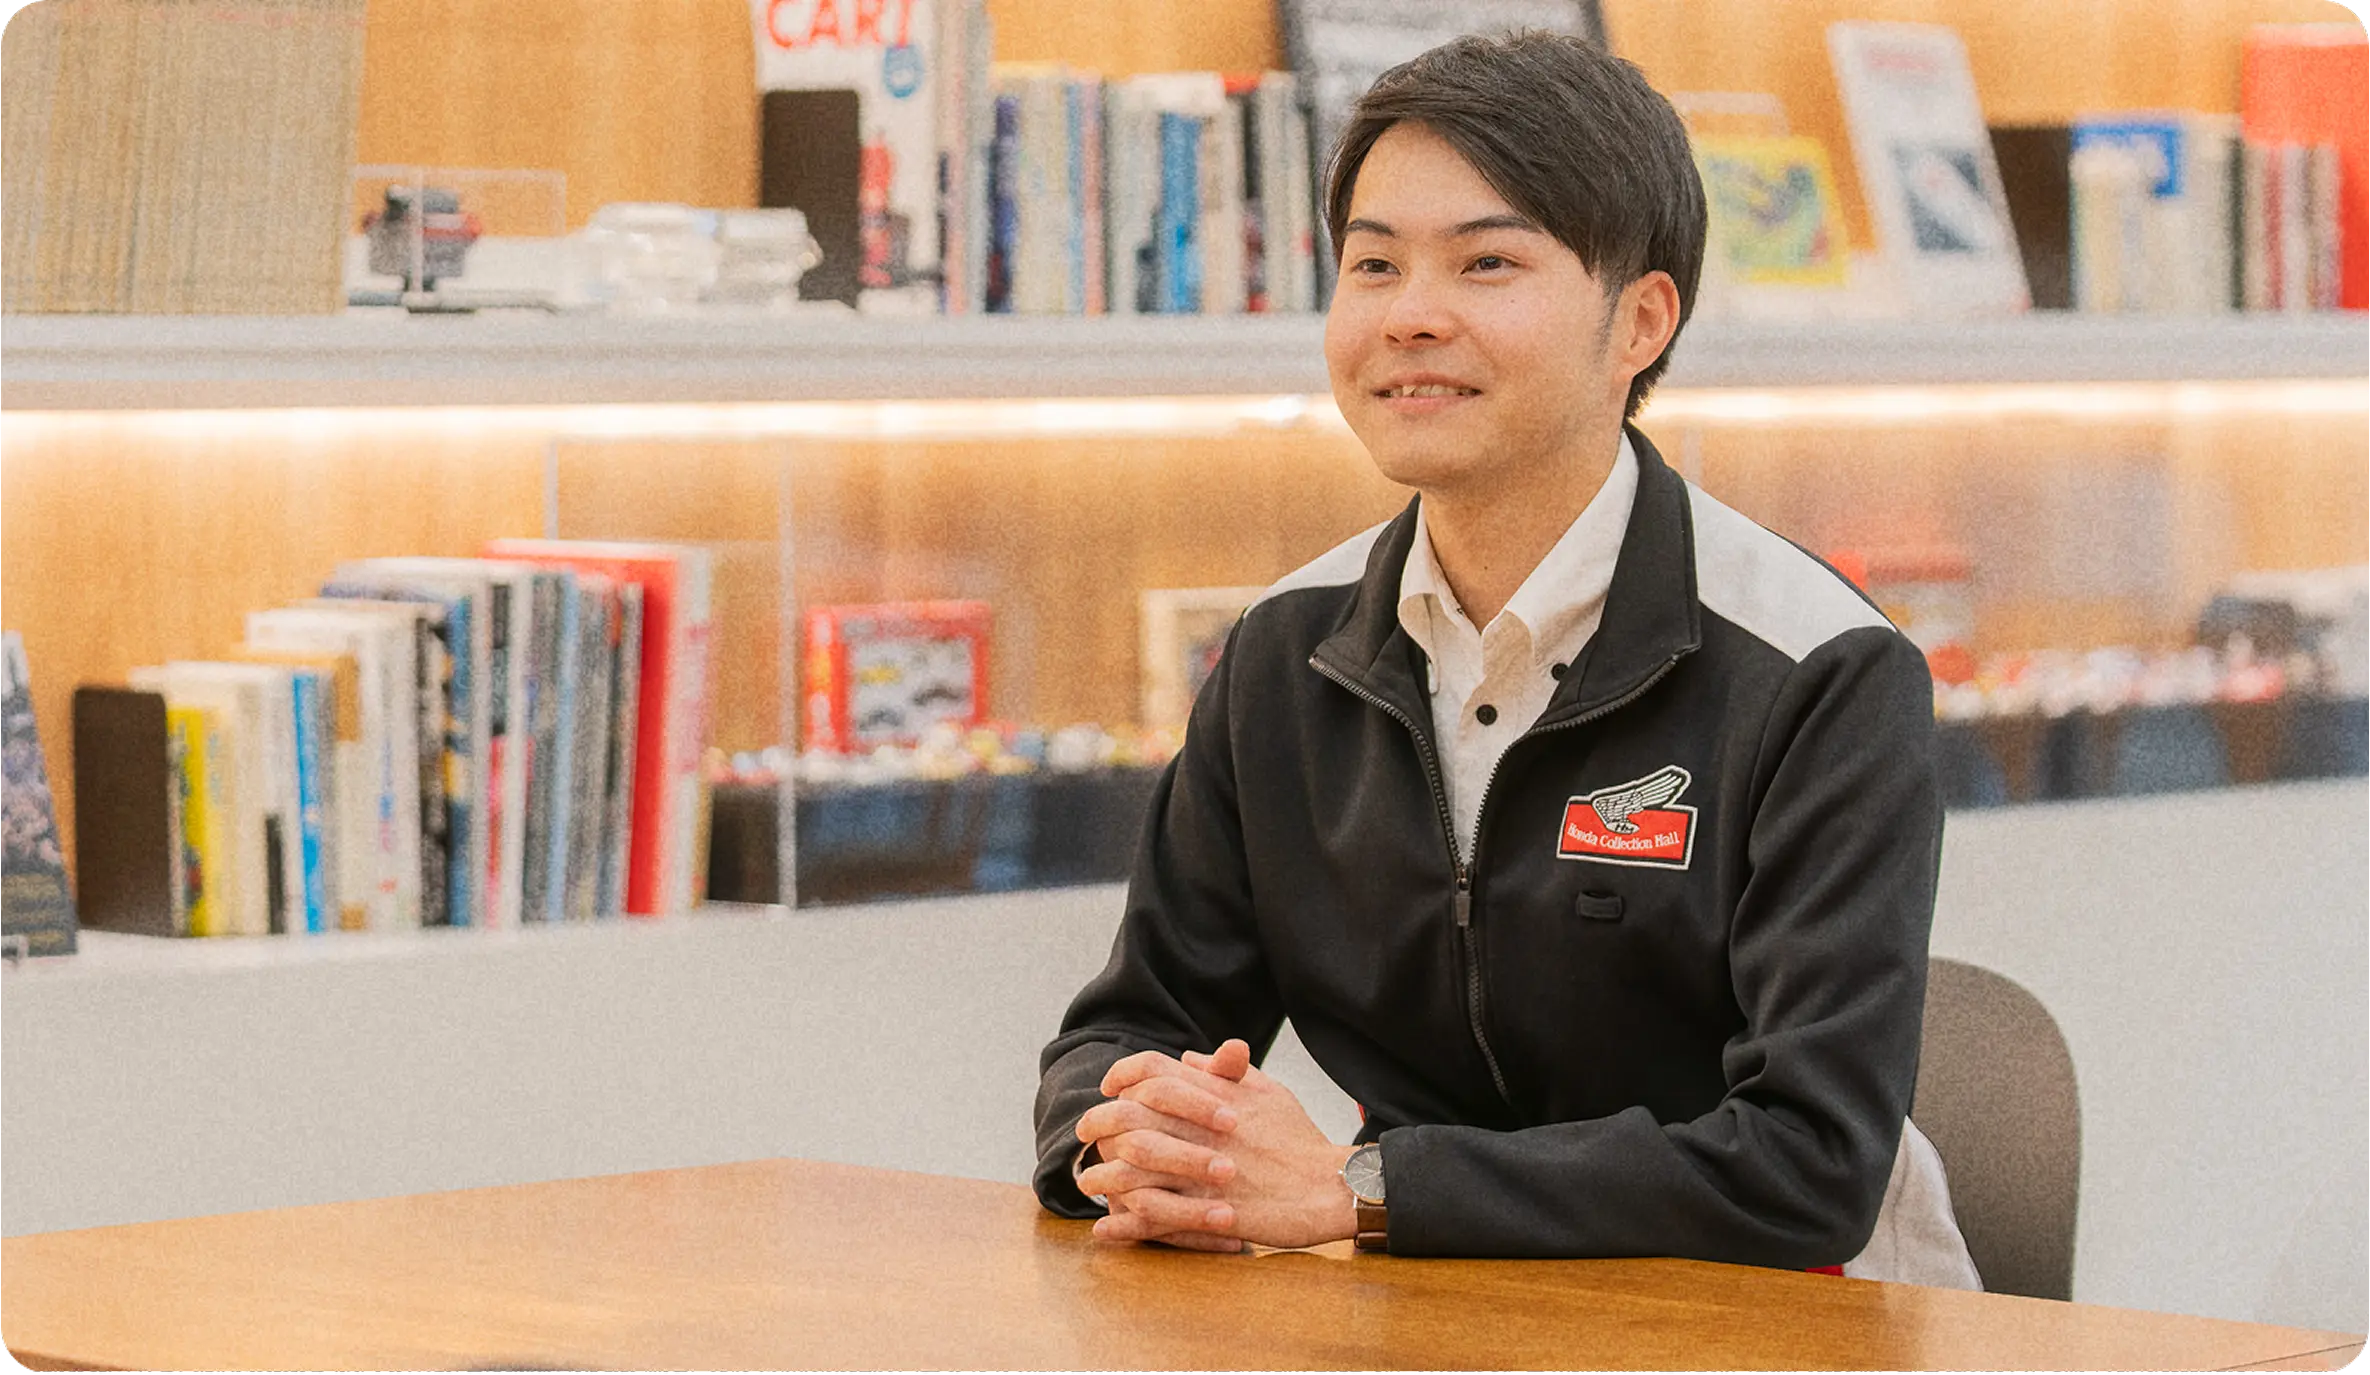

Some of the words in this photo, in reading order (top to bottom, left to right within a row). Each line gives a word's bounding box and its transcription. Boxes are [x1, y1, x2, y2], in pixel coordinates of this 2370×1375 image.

[1567, 823, 1599, 846] Honda
[1600, 835, 1654, 851] Collection
[1655, 831, 1681, 848] Hall
